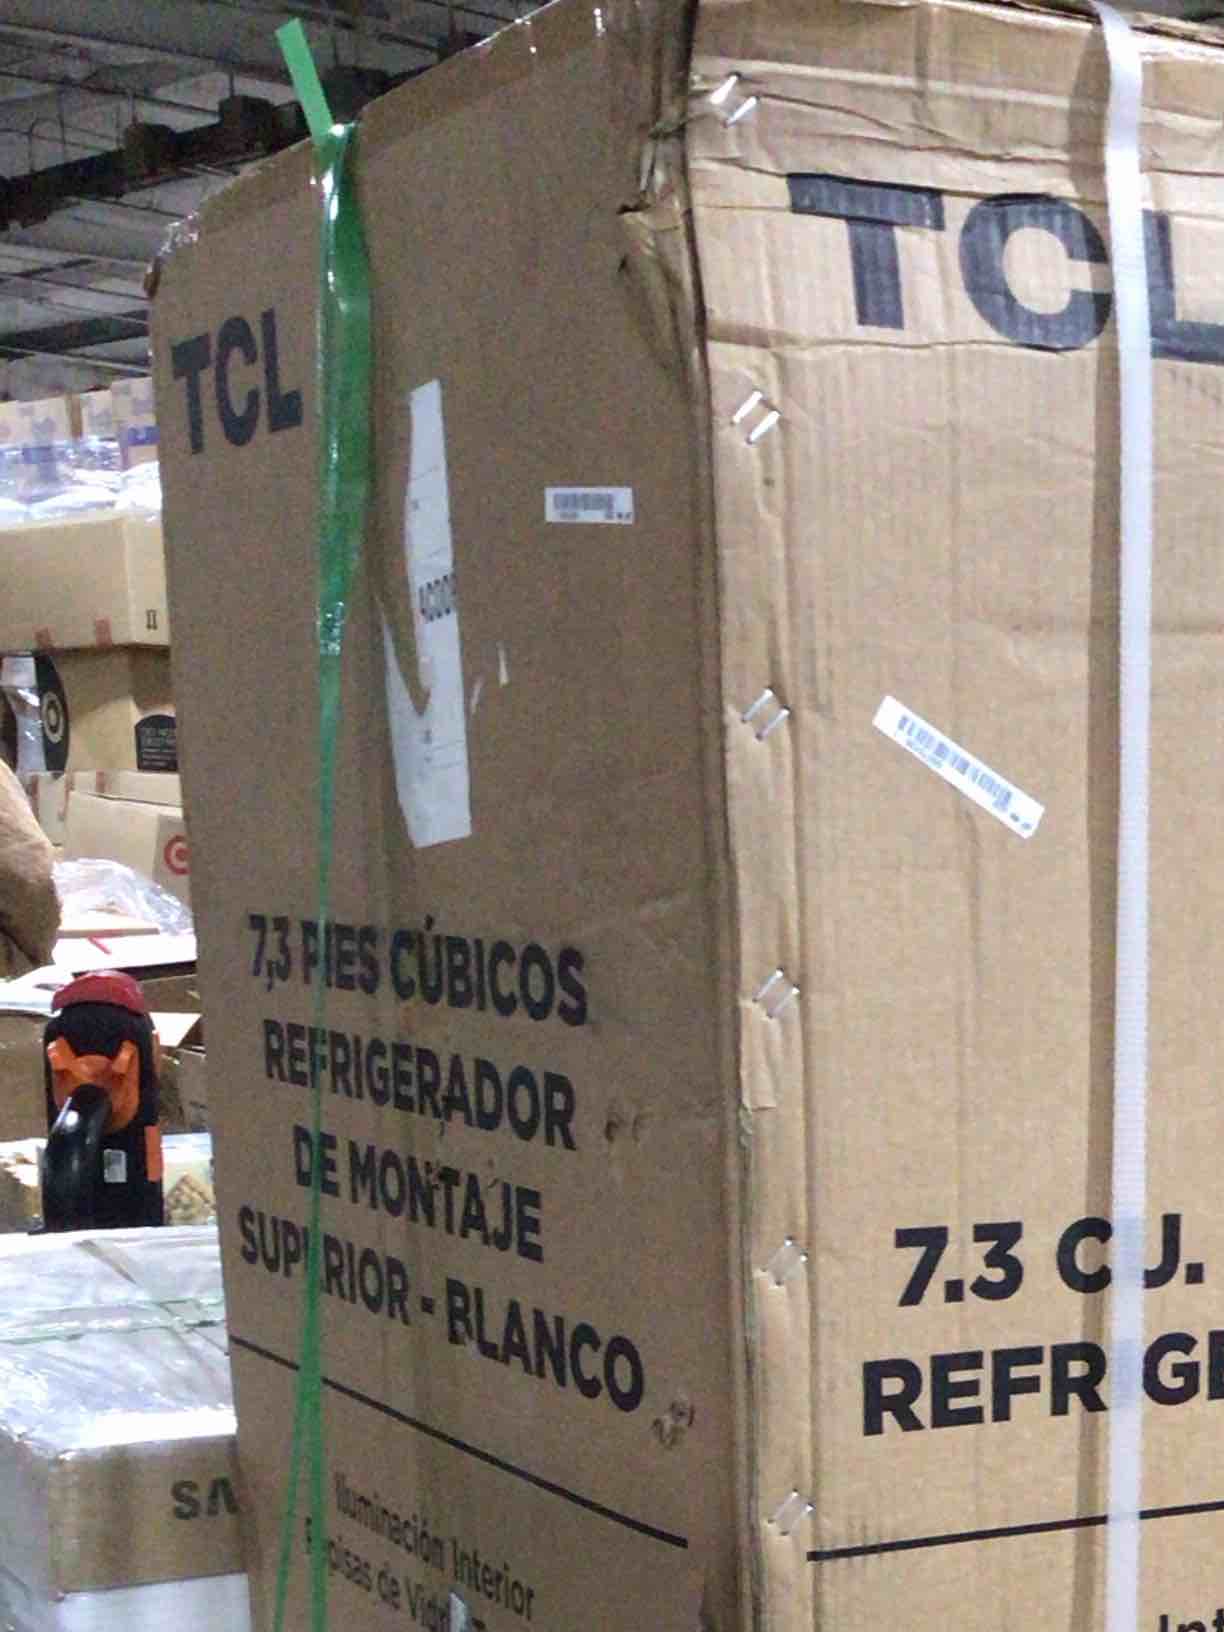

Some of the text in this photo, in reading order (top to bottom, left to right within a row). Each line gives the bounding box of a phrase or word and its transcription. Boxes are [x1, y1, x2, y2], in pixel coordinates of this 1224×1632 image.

[170, 307, 303, 455] TCL
[248, 914, 290, 992] 7,3
[390, 914, 589, 1027] CÚBICOS
[263, 1019, 577, 1151] REFRIGERADOR
[293, 1125, 544, 1264] DE MONTAJE
[894, 1220, 1024, 1307] 7.3
[421, 1296, 434, 1315] -
[446, 1277, 644, 1412] BLANCO
[378, 1560, 401, 1612] de
[452, 1536, 536, 1622] Interior
